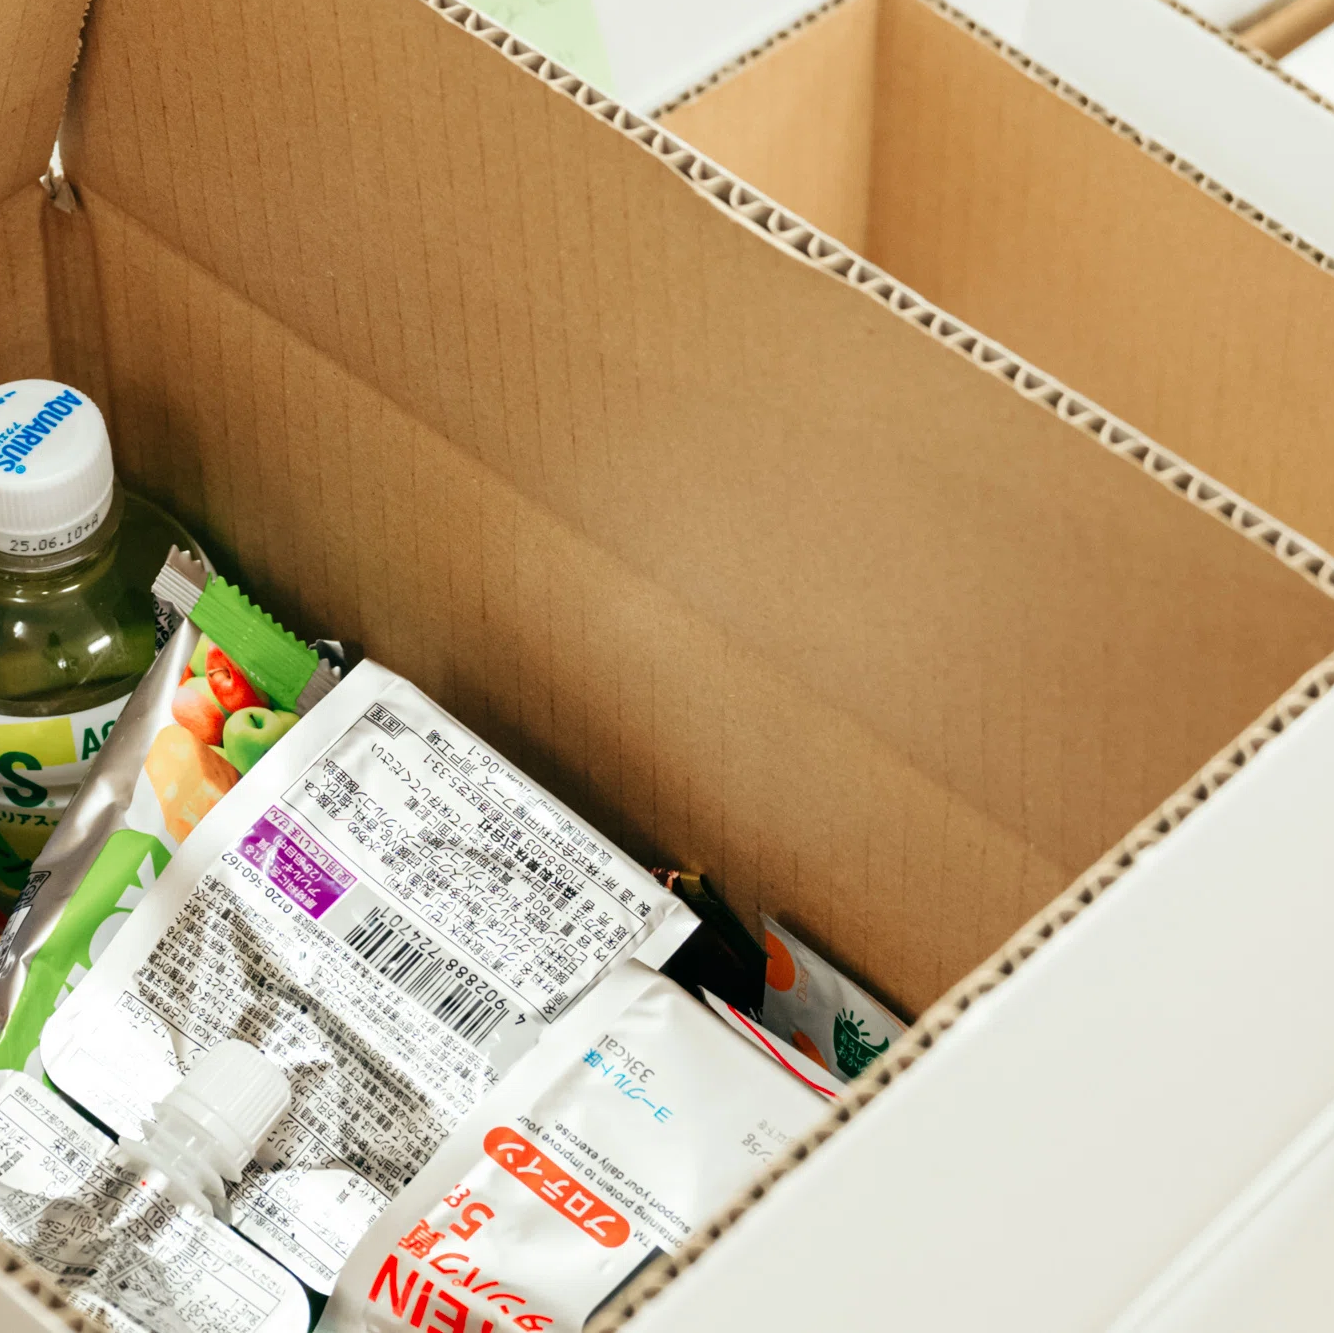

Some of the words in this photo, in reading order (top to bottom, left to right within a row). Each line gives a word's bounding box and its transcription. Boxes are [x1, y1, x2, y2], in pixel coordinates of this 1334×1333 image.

[368, 703, 401, 734] 国産
[421, 751, 526, 842] 東京都港区芝5-33-1
[220, 849, 295, 914] 0120-560-162
[597, 1033, 656, 1084] 33kcal
[579, 1046, 674, 1124] ヨーグルト味
[515, 1111, 543, 1137] your
[548, 1118, 600, 1162] exercise.
[538, 1130, 586, 1171] improve
[595, 1155, 626, 1184] daily
[492, 1133, 618, 1238] プロテイン
[594, 1173, 636, 1210] protein
[622, 1174, 652, 1201] your
[647, 1194, 694, 1235] support
[396, 1215, 558, 1333] タンパク質
